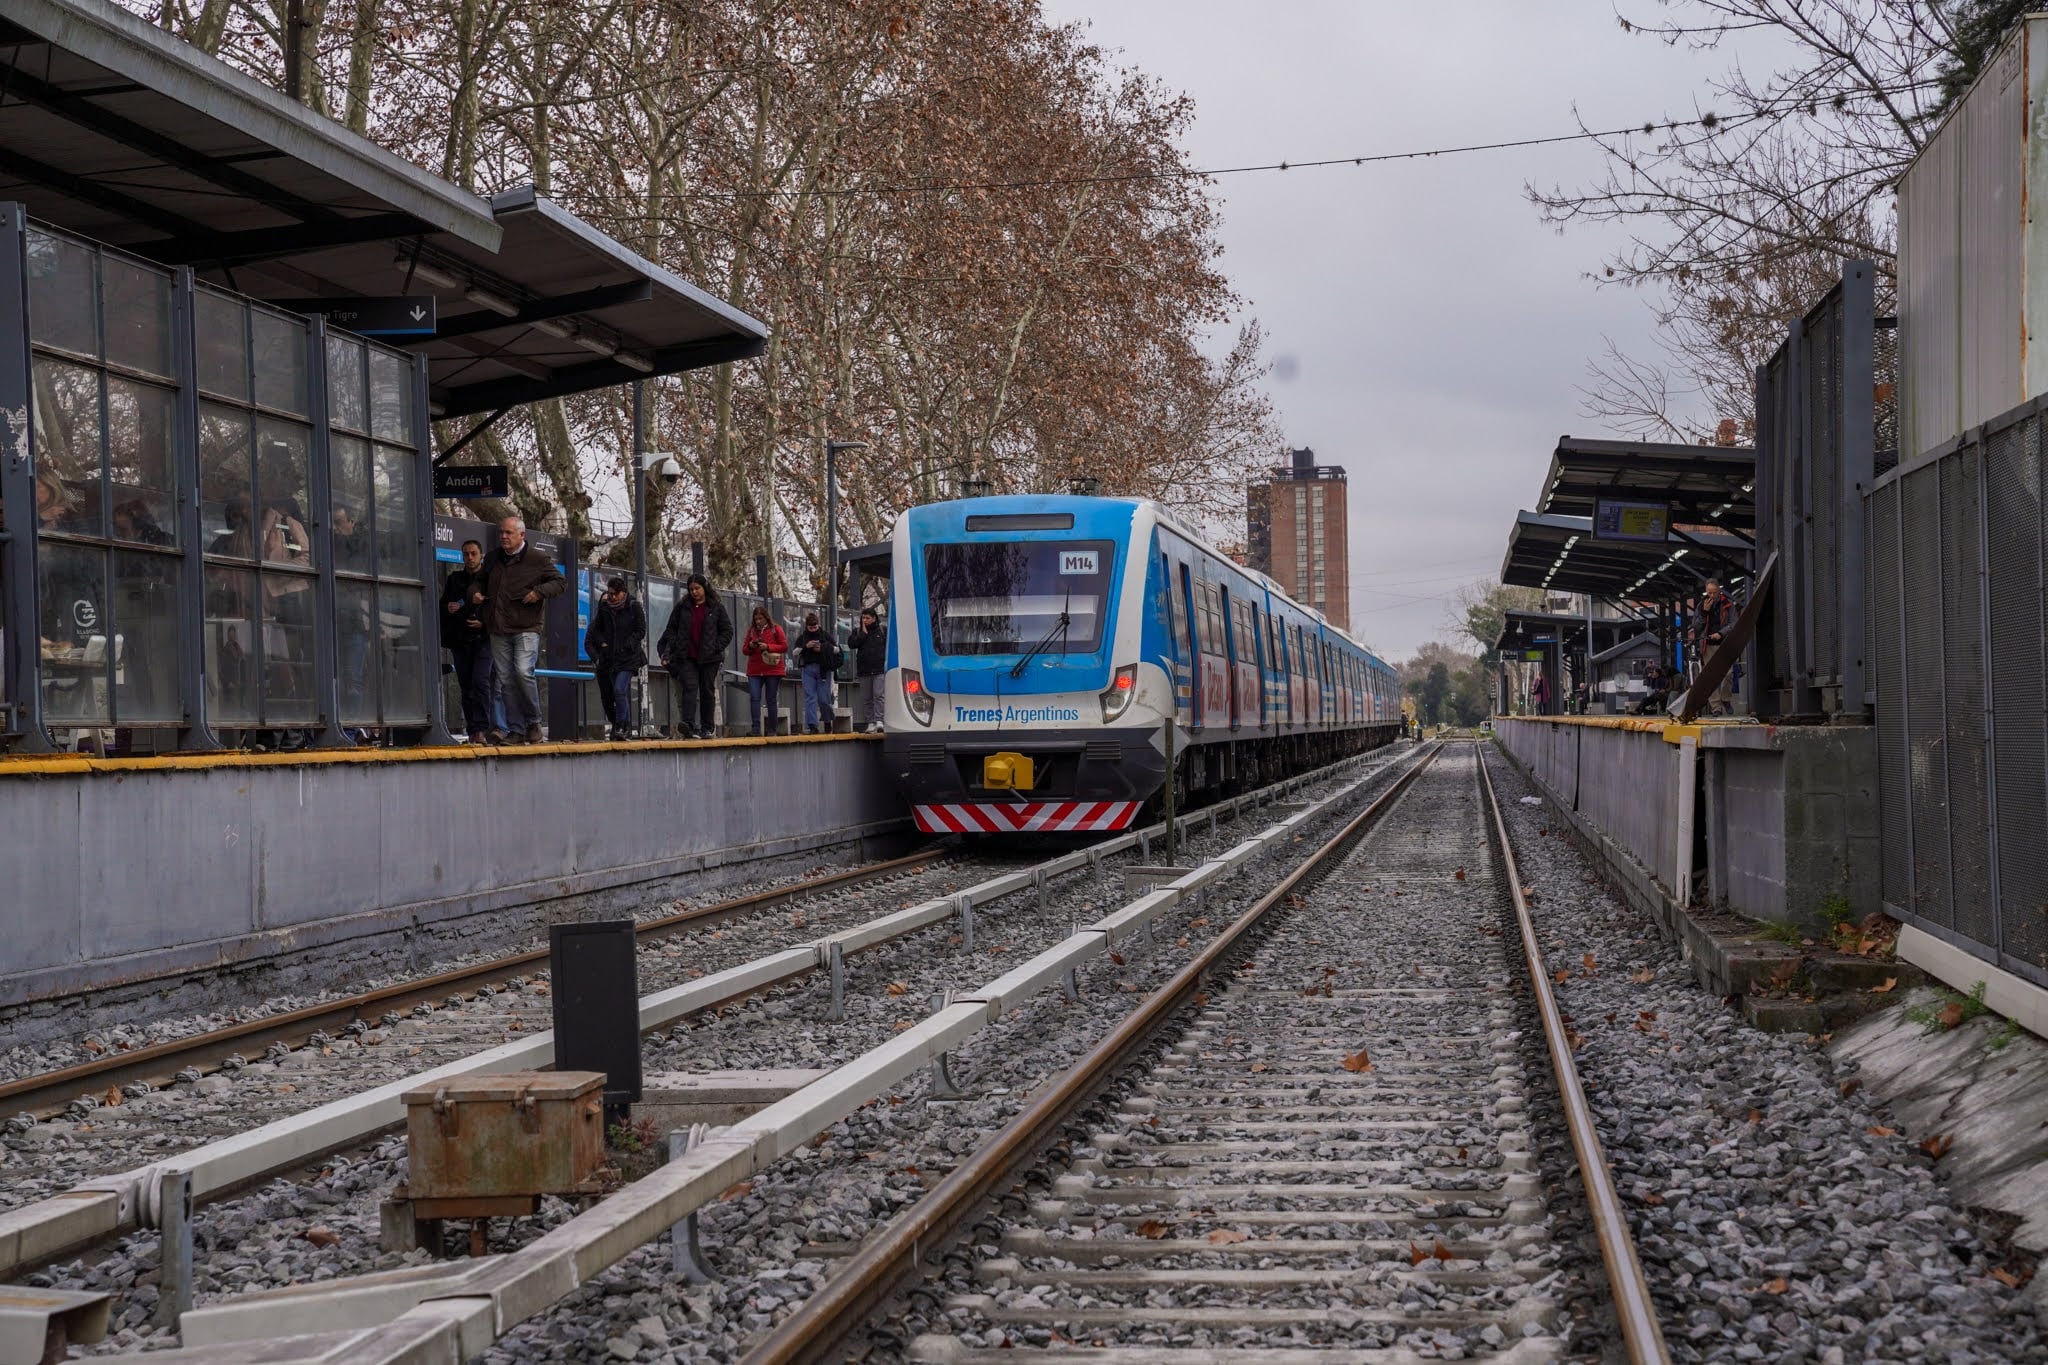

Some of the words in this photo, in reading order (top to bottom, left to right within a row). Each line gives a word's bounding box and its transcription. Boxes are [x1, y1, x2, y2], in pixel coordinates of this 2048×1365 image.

[333, 310, 358, 321] Tigre
[445, 475, 482, 487] Andén
[486, 475, 491, 486] 1
[435, 522, 453, 541] Isidro
[1065, 556, 1093, 570] M14
[955, 706, 1003, 722] Trenes
[1005, 705, 1079, 724] Argentinos
